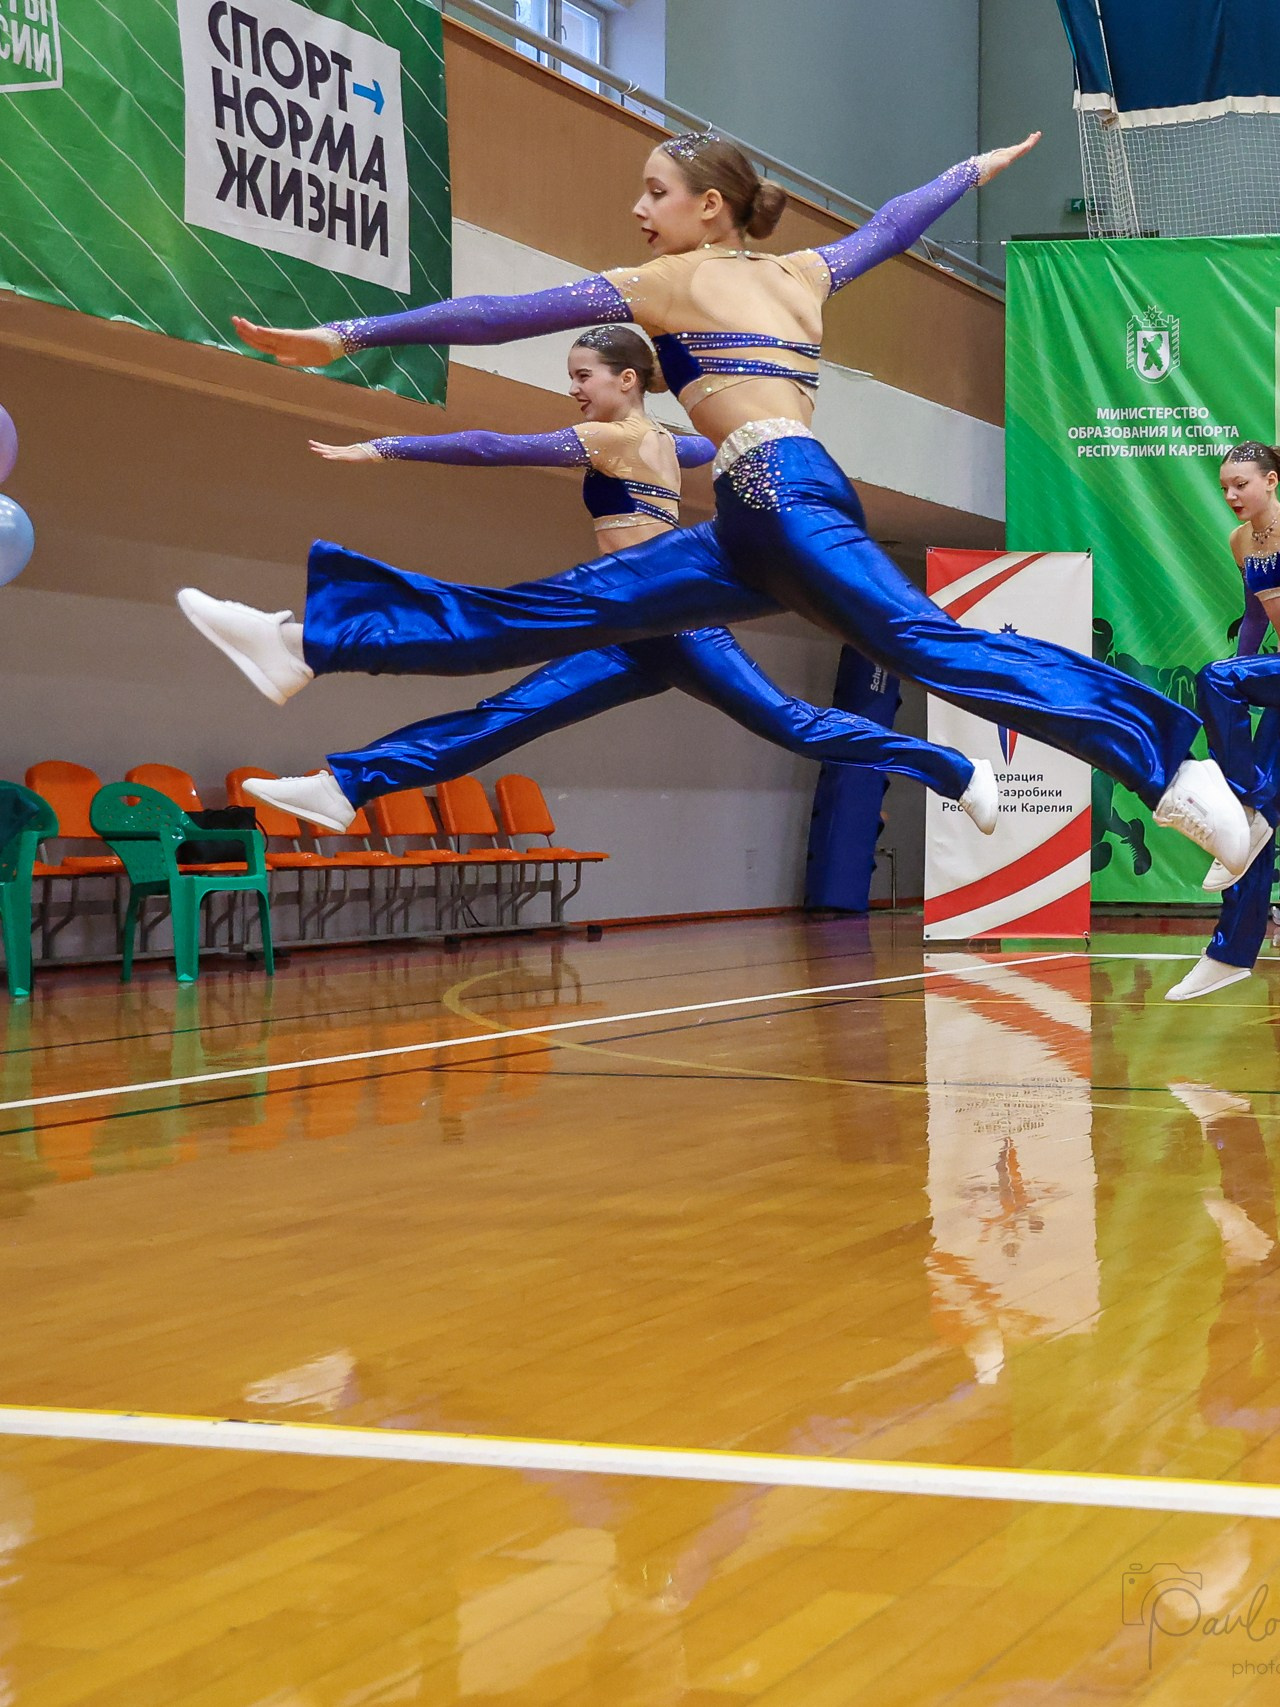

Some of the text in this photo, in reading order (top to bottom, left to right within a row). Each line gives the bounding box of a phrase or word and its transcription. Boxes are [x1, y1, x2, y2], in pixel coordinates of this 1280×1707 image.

[208, 0, 353, 112] СПОРТ
[211, 67, 388, 192] НОРМА
[215, 138, 389, 258] ЖИЗНИ
[1096, 407, 1209, 420] МИНИСТЕРСТВО
[1068, 425, 1239, 439] ОБРАЗОВАНИЯ И СПОРТА
[1077, 444, 1165, 457] РЕСПУБЛИКИ
[994, 773, 1044, 784] дерация
[1021, 802, 1073, 814] Карелия
